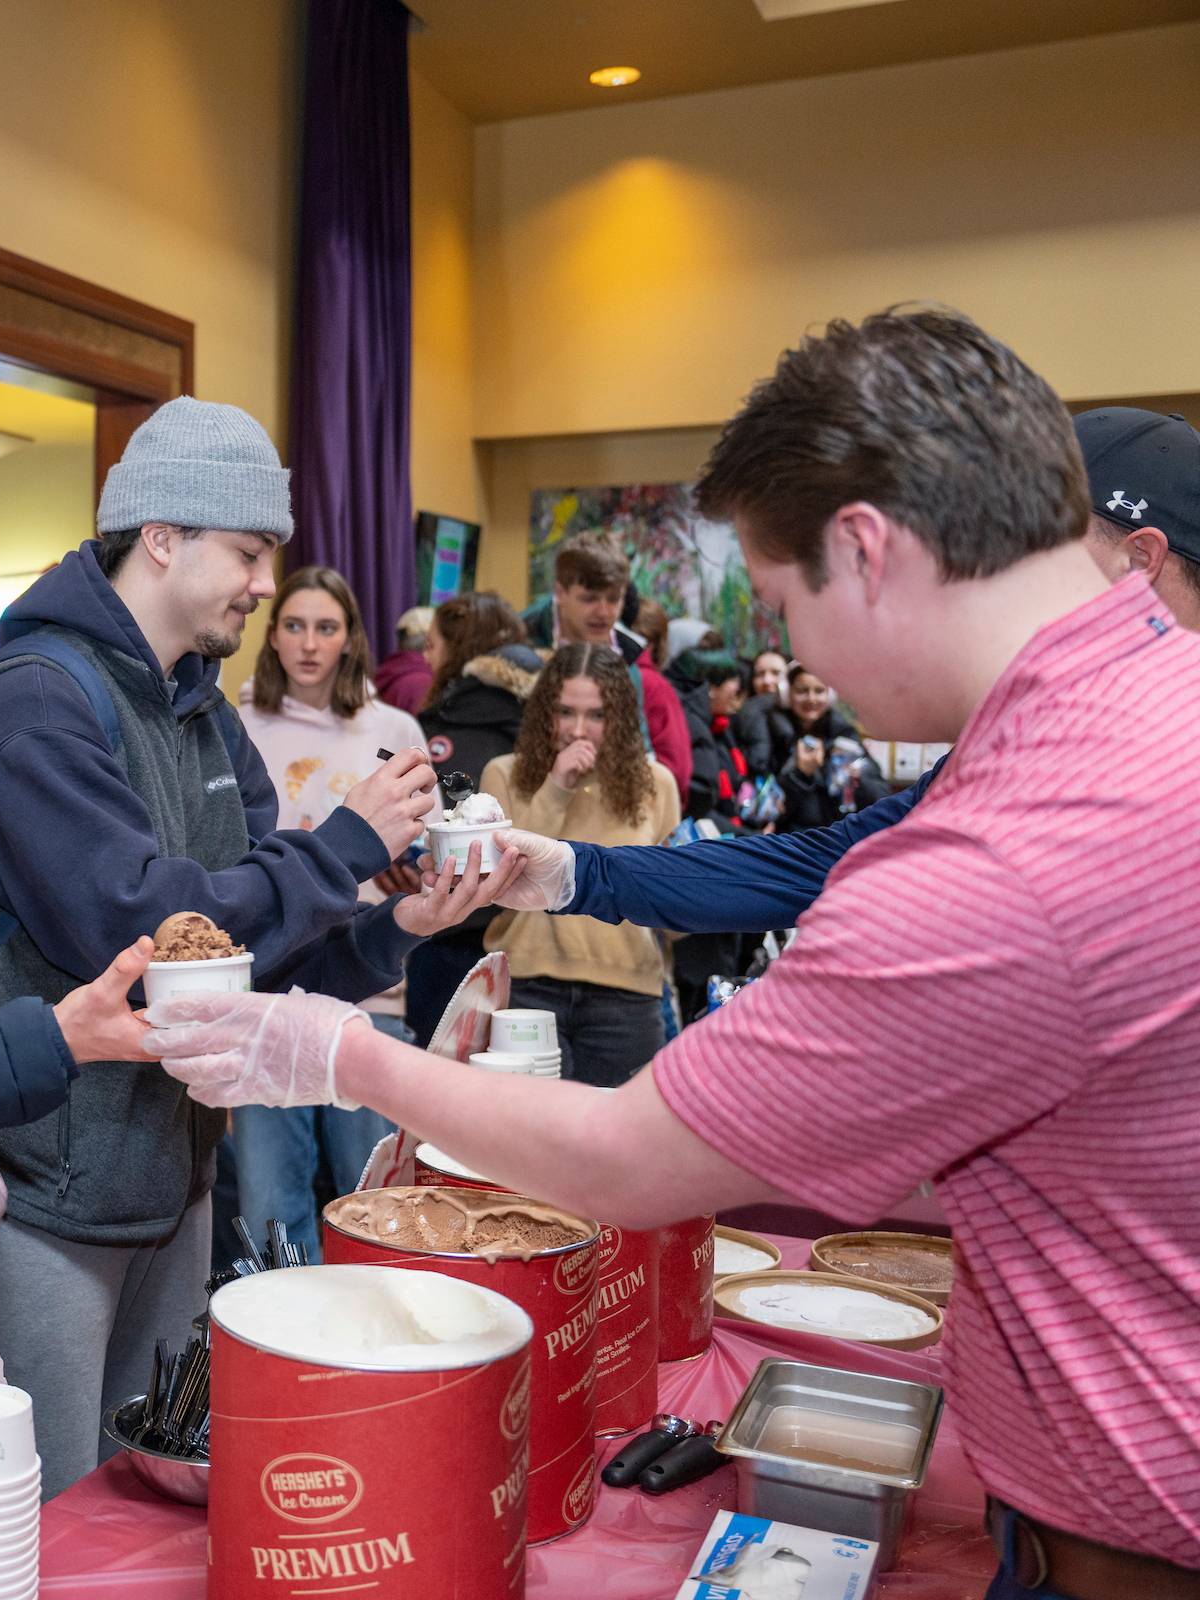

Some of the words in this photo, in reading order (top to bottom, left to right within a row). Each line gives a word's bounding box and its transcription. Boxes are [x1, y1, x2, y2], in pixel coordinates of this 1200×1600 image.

[270, 1468, 347, 1491] HERSHEY'S
[278, 1492, 297, 1509] Ice
[299, 1492, 348, 1509] Cream
[251, 1532, 416, 1581] PREMIUM
